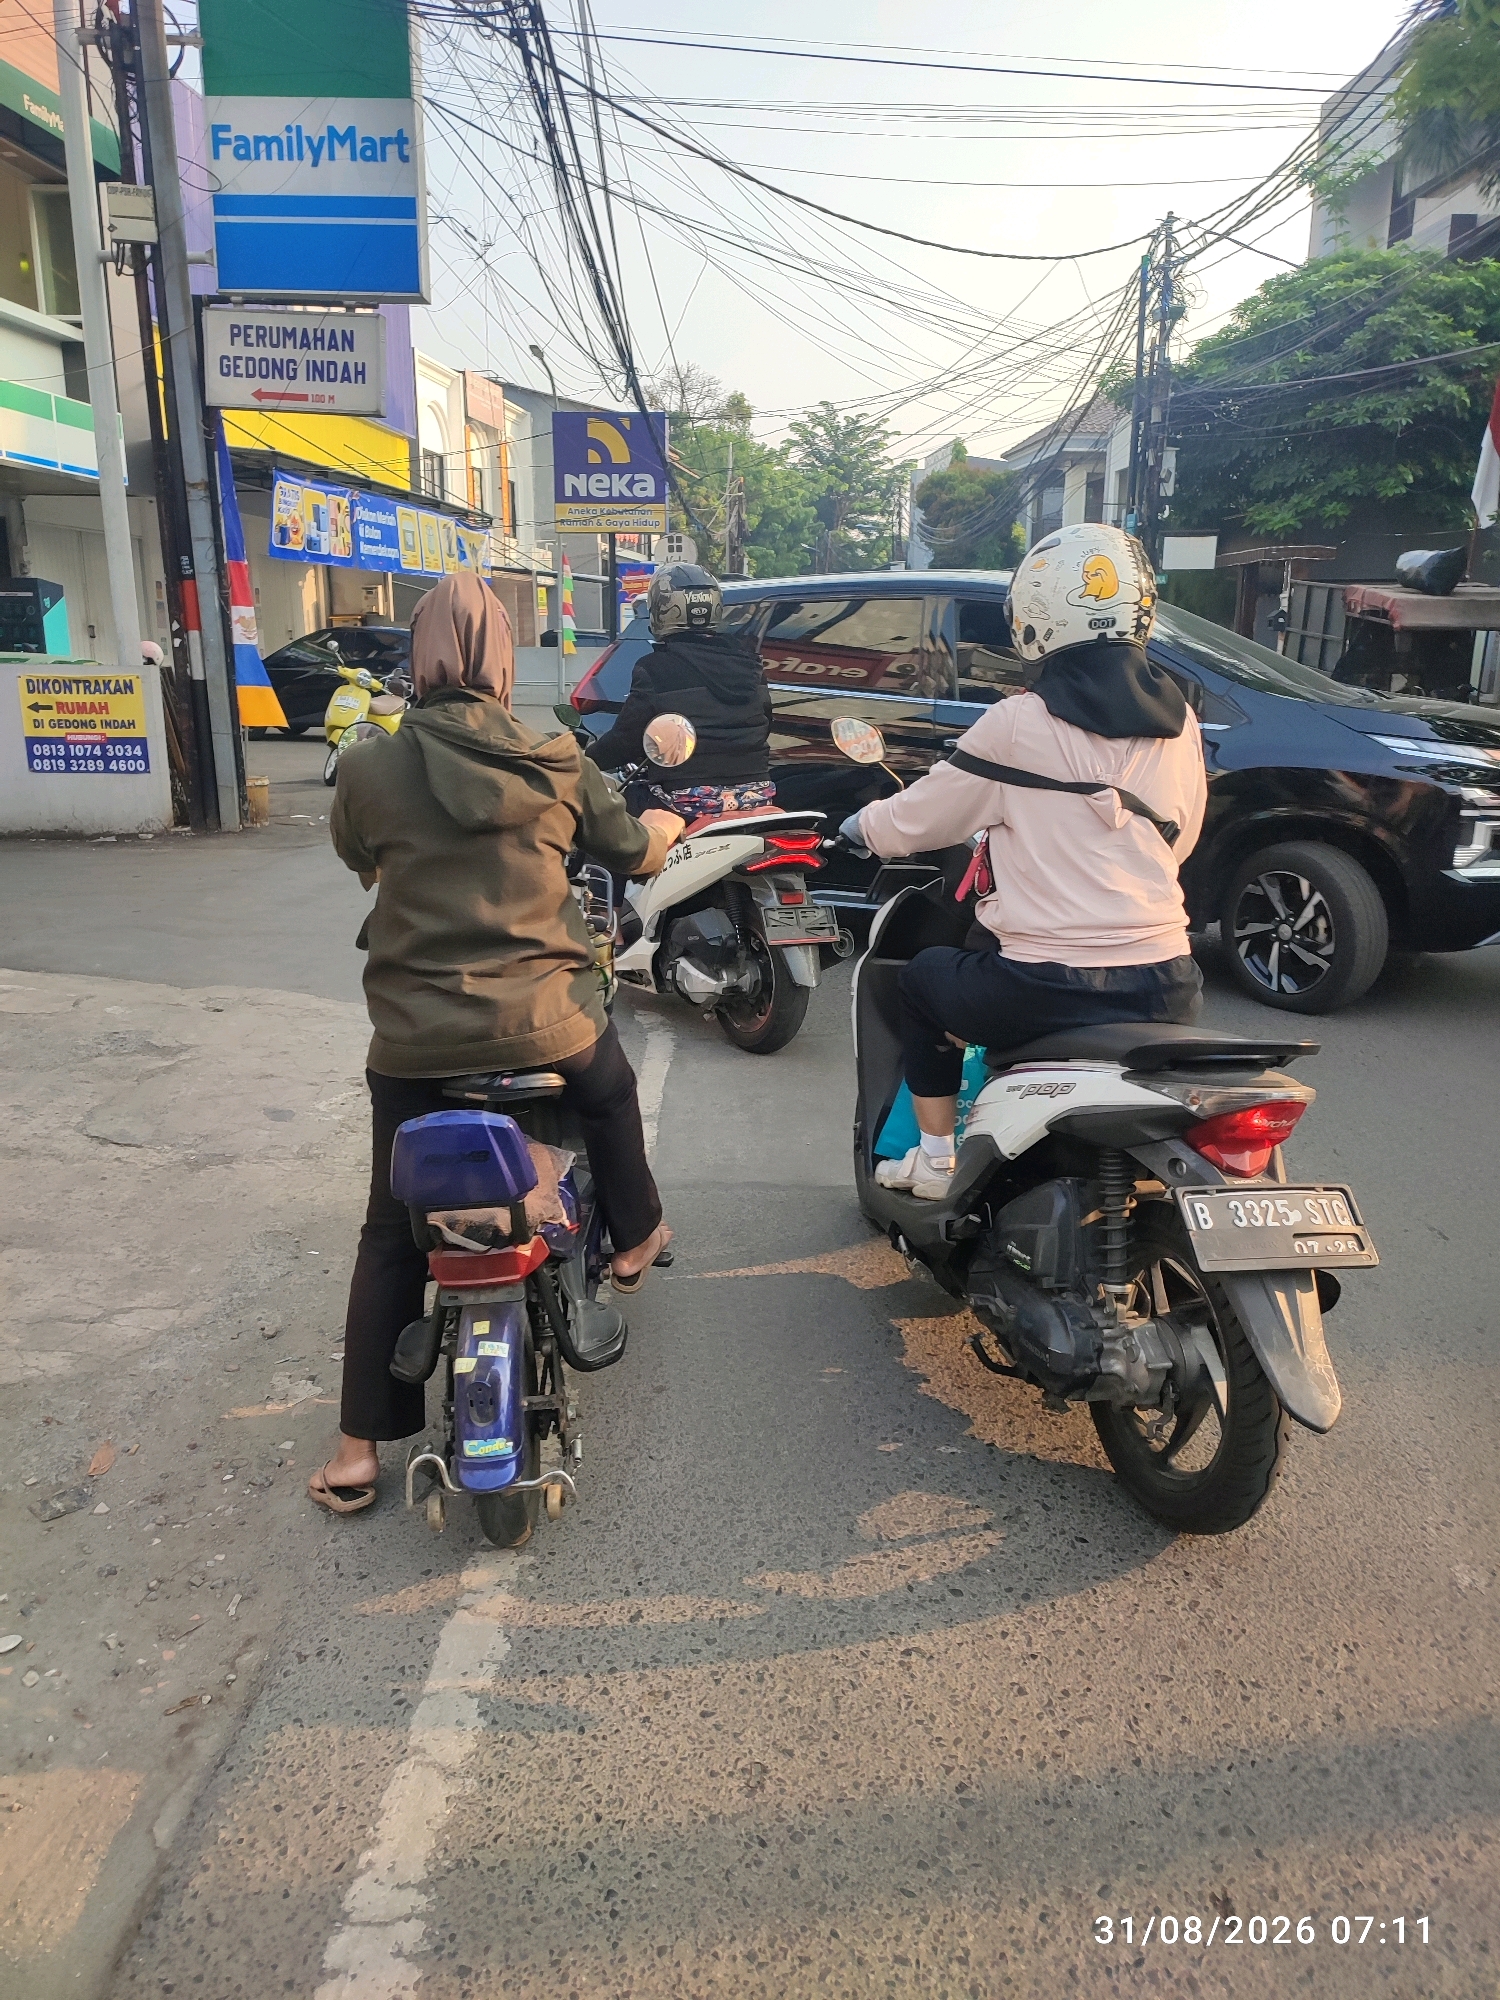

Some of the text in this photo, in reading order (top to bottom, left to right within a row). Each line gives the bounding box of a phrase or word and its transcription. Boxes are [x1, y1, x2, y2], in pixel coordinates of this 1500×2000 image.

[210, 123, 411, 168] FamilyMart
[229, 323, 355, 353] PERUMAHAN
[219, 354, 366, 385] GEDONG INDAH
[311, 393, 335, 404] 100 M
[567, 506, 598, 515] Aneka
[560, 518, 661, 529] Rumah & Gaya Hidup
[684, 591, 713, 604] VENOM
[1091, 617, 1114, 629] DOT
[26, 678, 134, 695] DIKONTRAKAN
[55, 701, 110, 715] RUMAH
[32, 718, 136, 729] DI GEDONG INDAH
[33, 744, 143, 757] 0813 1074 3034
[33, 759, 146, 771] 0819 3289 4600
[1018, 1082, 1077, 1100] pop
[1193, 1202, 1214, 1230] B
[1228, 1199, 1294, 1228] 3325
